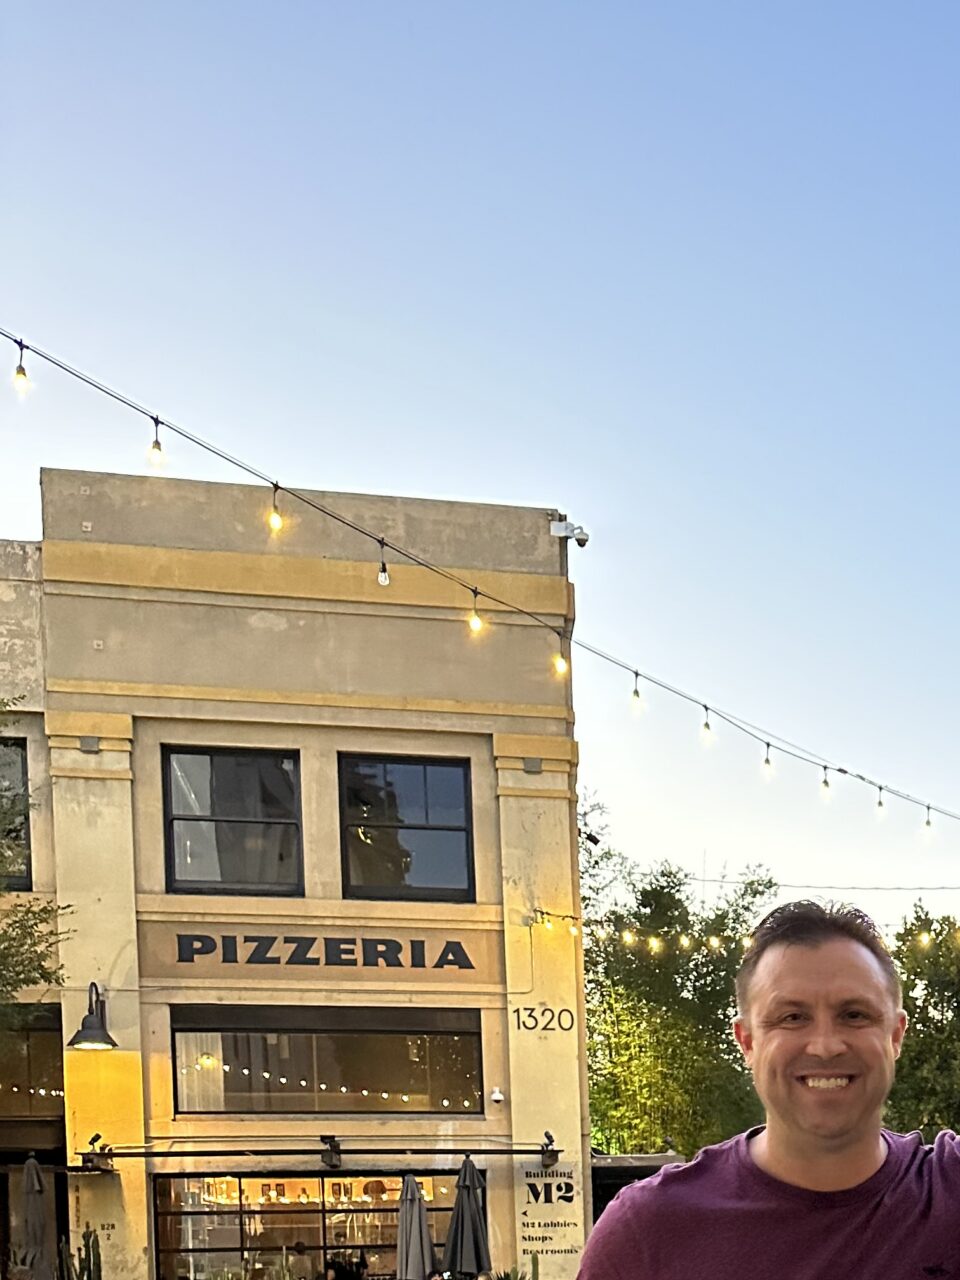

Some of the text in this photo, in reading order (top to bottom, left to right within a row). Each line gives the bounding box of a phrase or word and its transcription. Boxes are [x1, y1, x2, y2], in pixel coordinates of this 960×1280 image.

[176, 933, 476, 970] PIZZERIA
[513, 1007, 575, 1031] 1320
[525, 1170, 574, 1179] Building
[525, 1181, 575, 1205] M2
[538, 1220, 578, 1228] Lobbies
[521, 1234, 553, 1243] Shops
[522, 1248, 579, 1256] Restrooms
